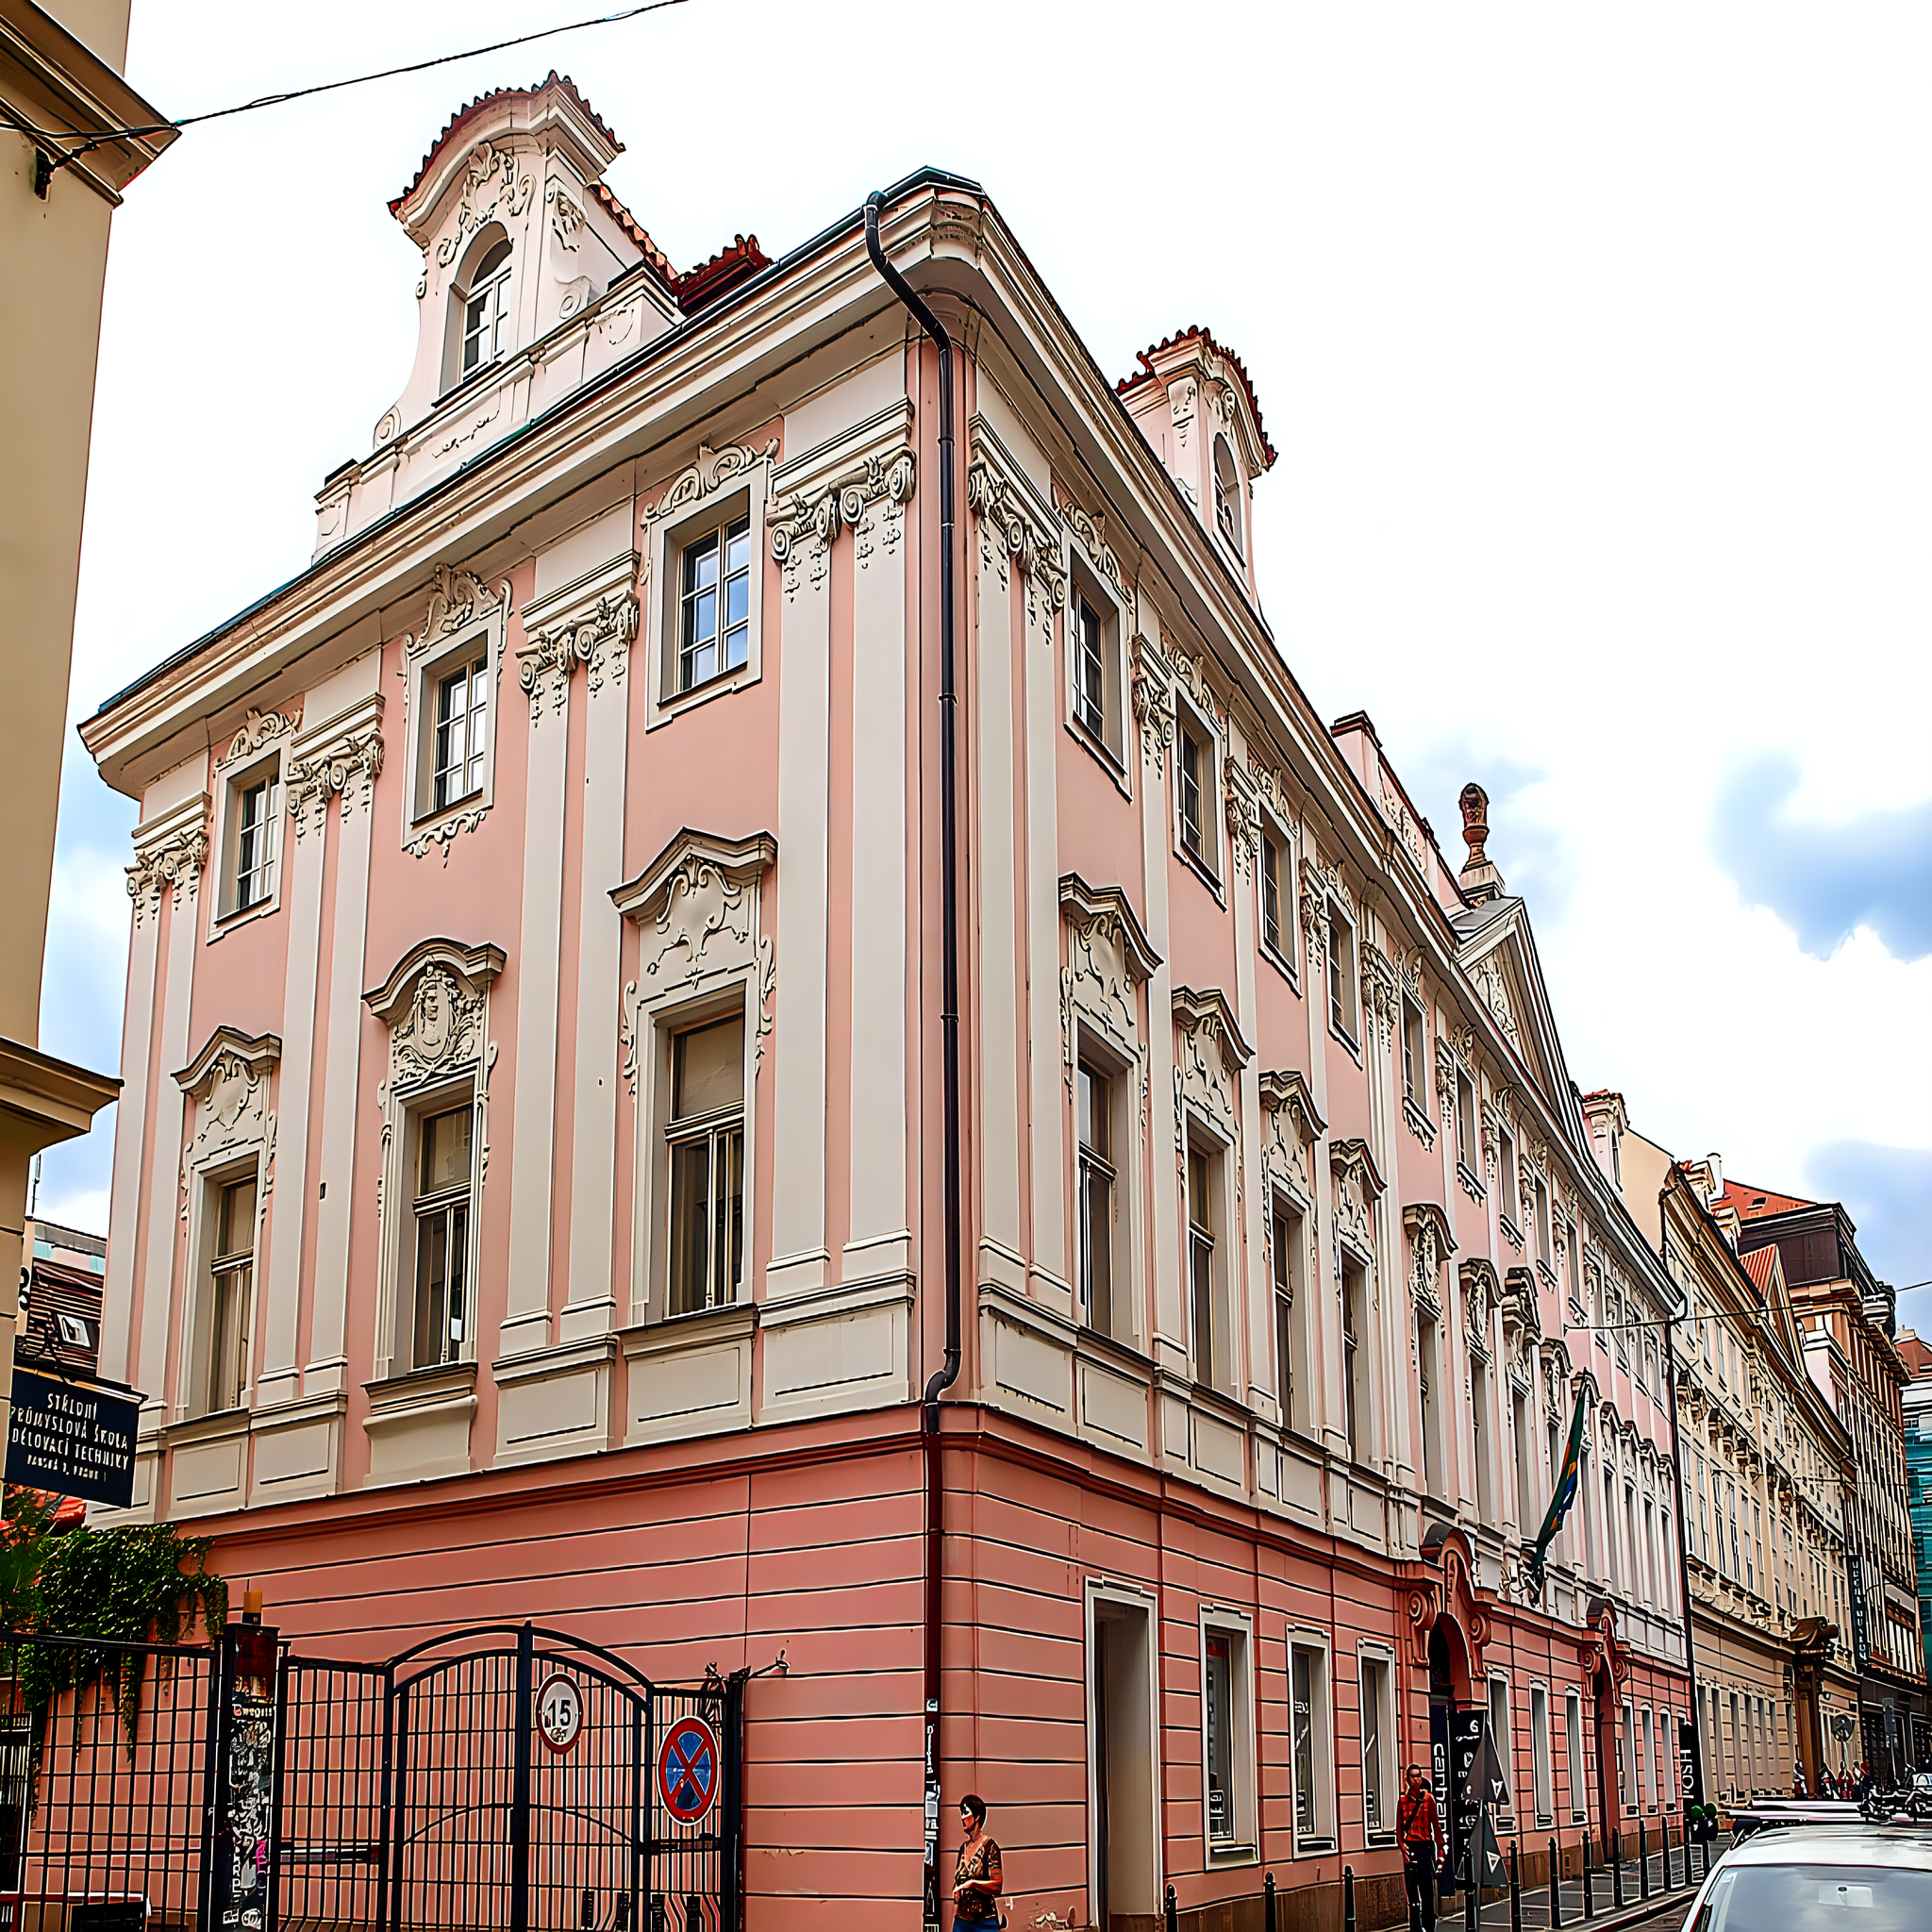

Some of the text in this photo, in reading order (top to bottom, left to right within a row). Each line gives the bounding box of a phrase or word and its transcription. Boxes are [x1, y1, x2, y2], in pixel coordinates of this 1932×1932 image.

[94, 1424, 128, 1450] ŠKOLA
[75, 1443, 129, 1471] TECHNIKY
[547, 1699, 572, 1727] 15
